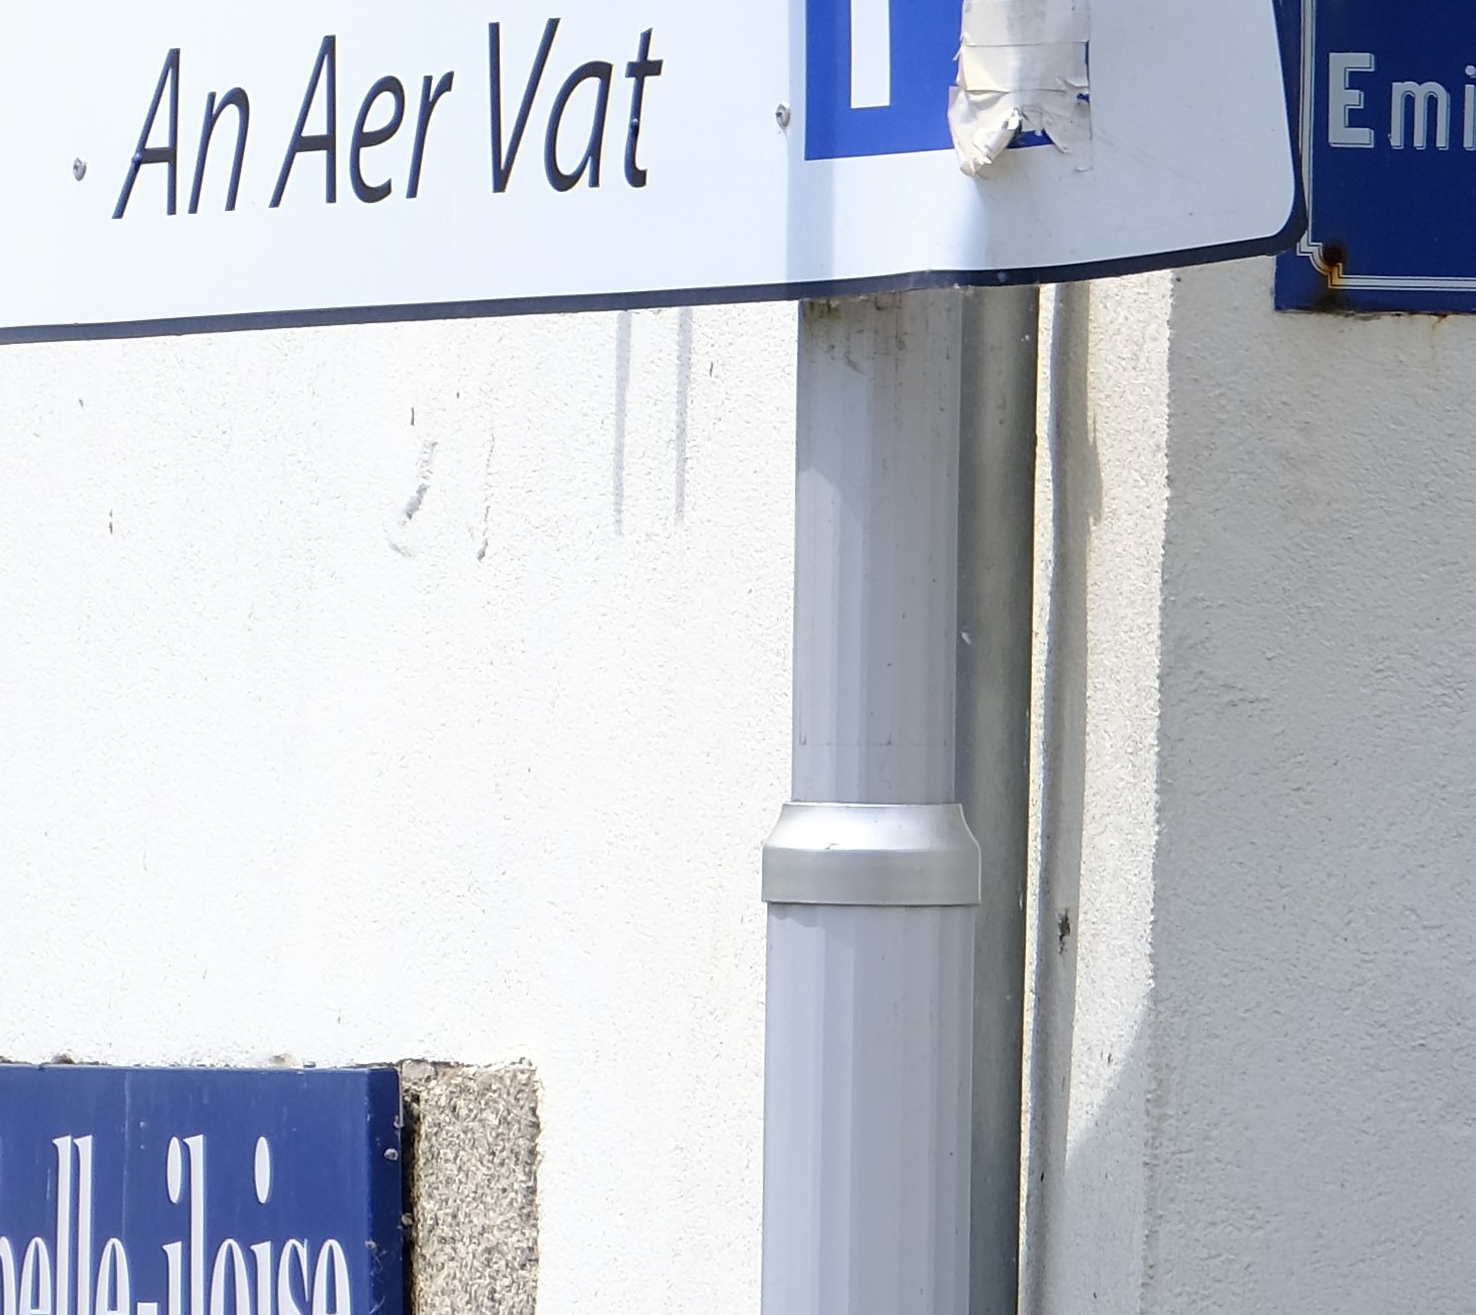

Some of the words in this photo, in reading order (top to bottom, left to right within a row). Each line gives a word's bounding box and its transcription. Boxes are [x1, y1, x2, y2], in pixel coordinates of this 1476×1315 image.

[111, 47, 250, 220] An
[268, 34, 455, 209] Aer
[488, 17, 664, 194] Vat
